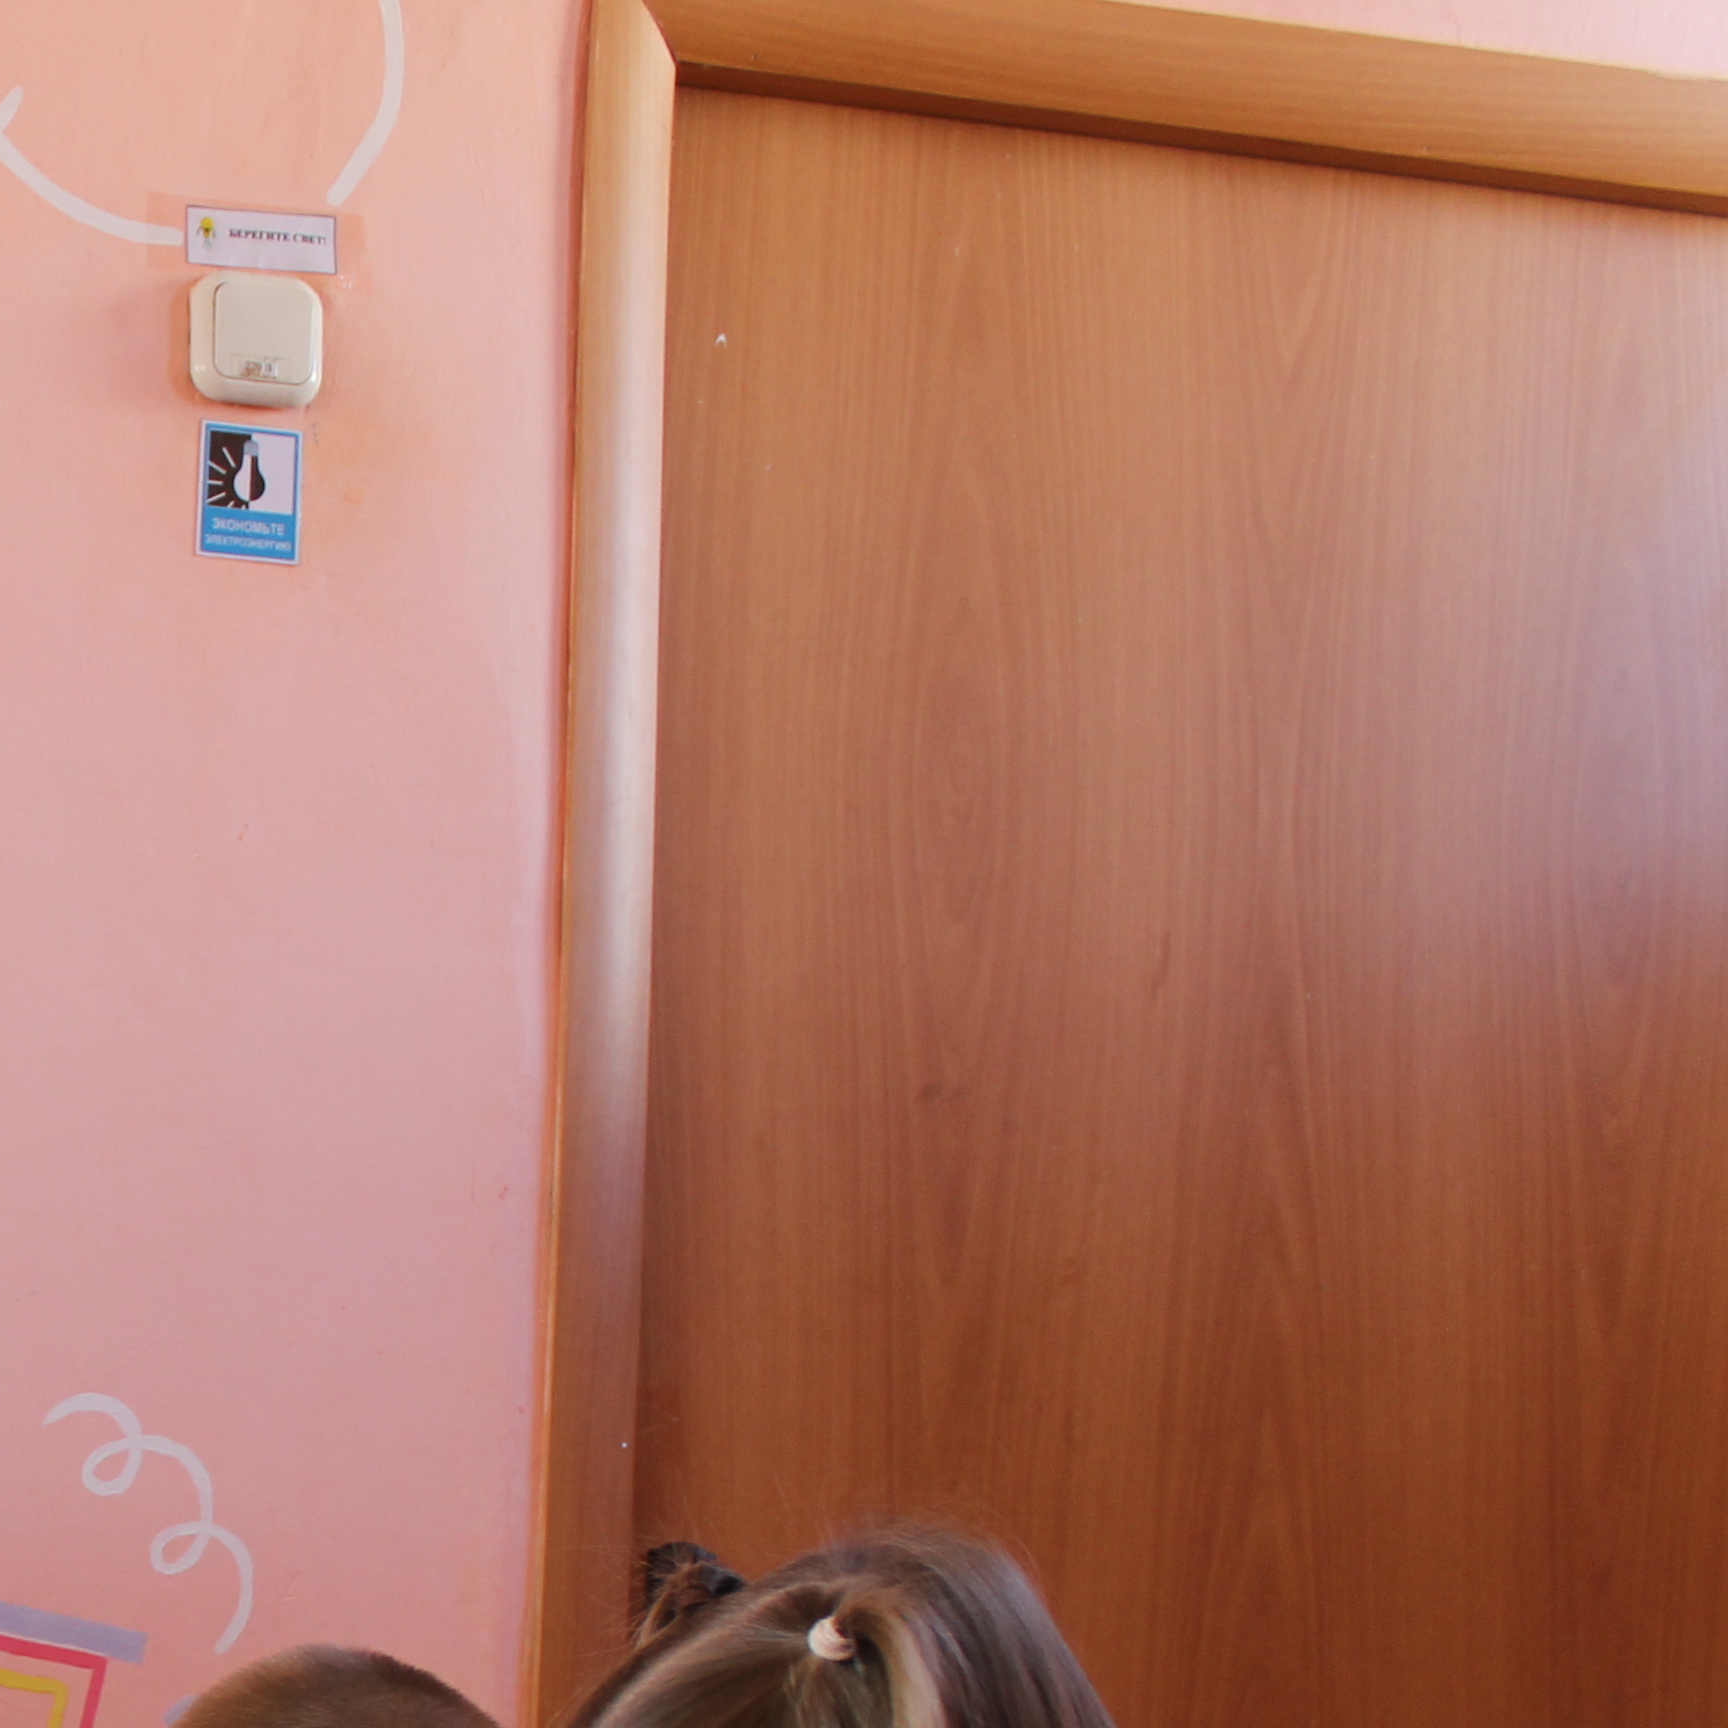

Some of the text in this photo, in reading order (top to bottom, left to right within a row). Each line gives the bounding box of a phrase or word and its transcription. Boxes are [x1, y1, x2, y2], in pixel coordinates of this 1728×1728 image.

[229, 229, 326, 245] БЕРЕГИТЕ СВЕТ!
[212, 517, 285, 535] ЭКОНОМЬТЕ
